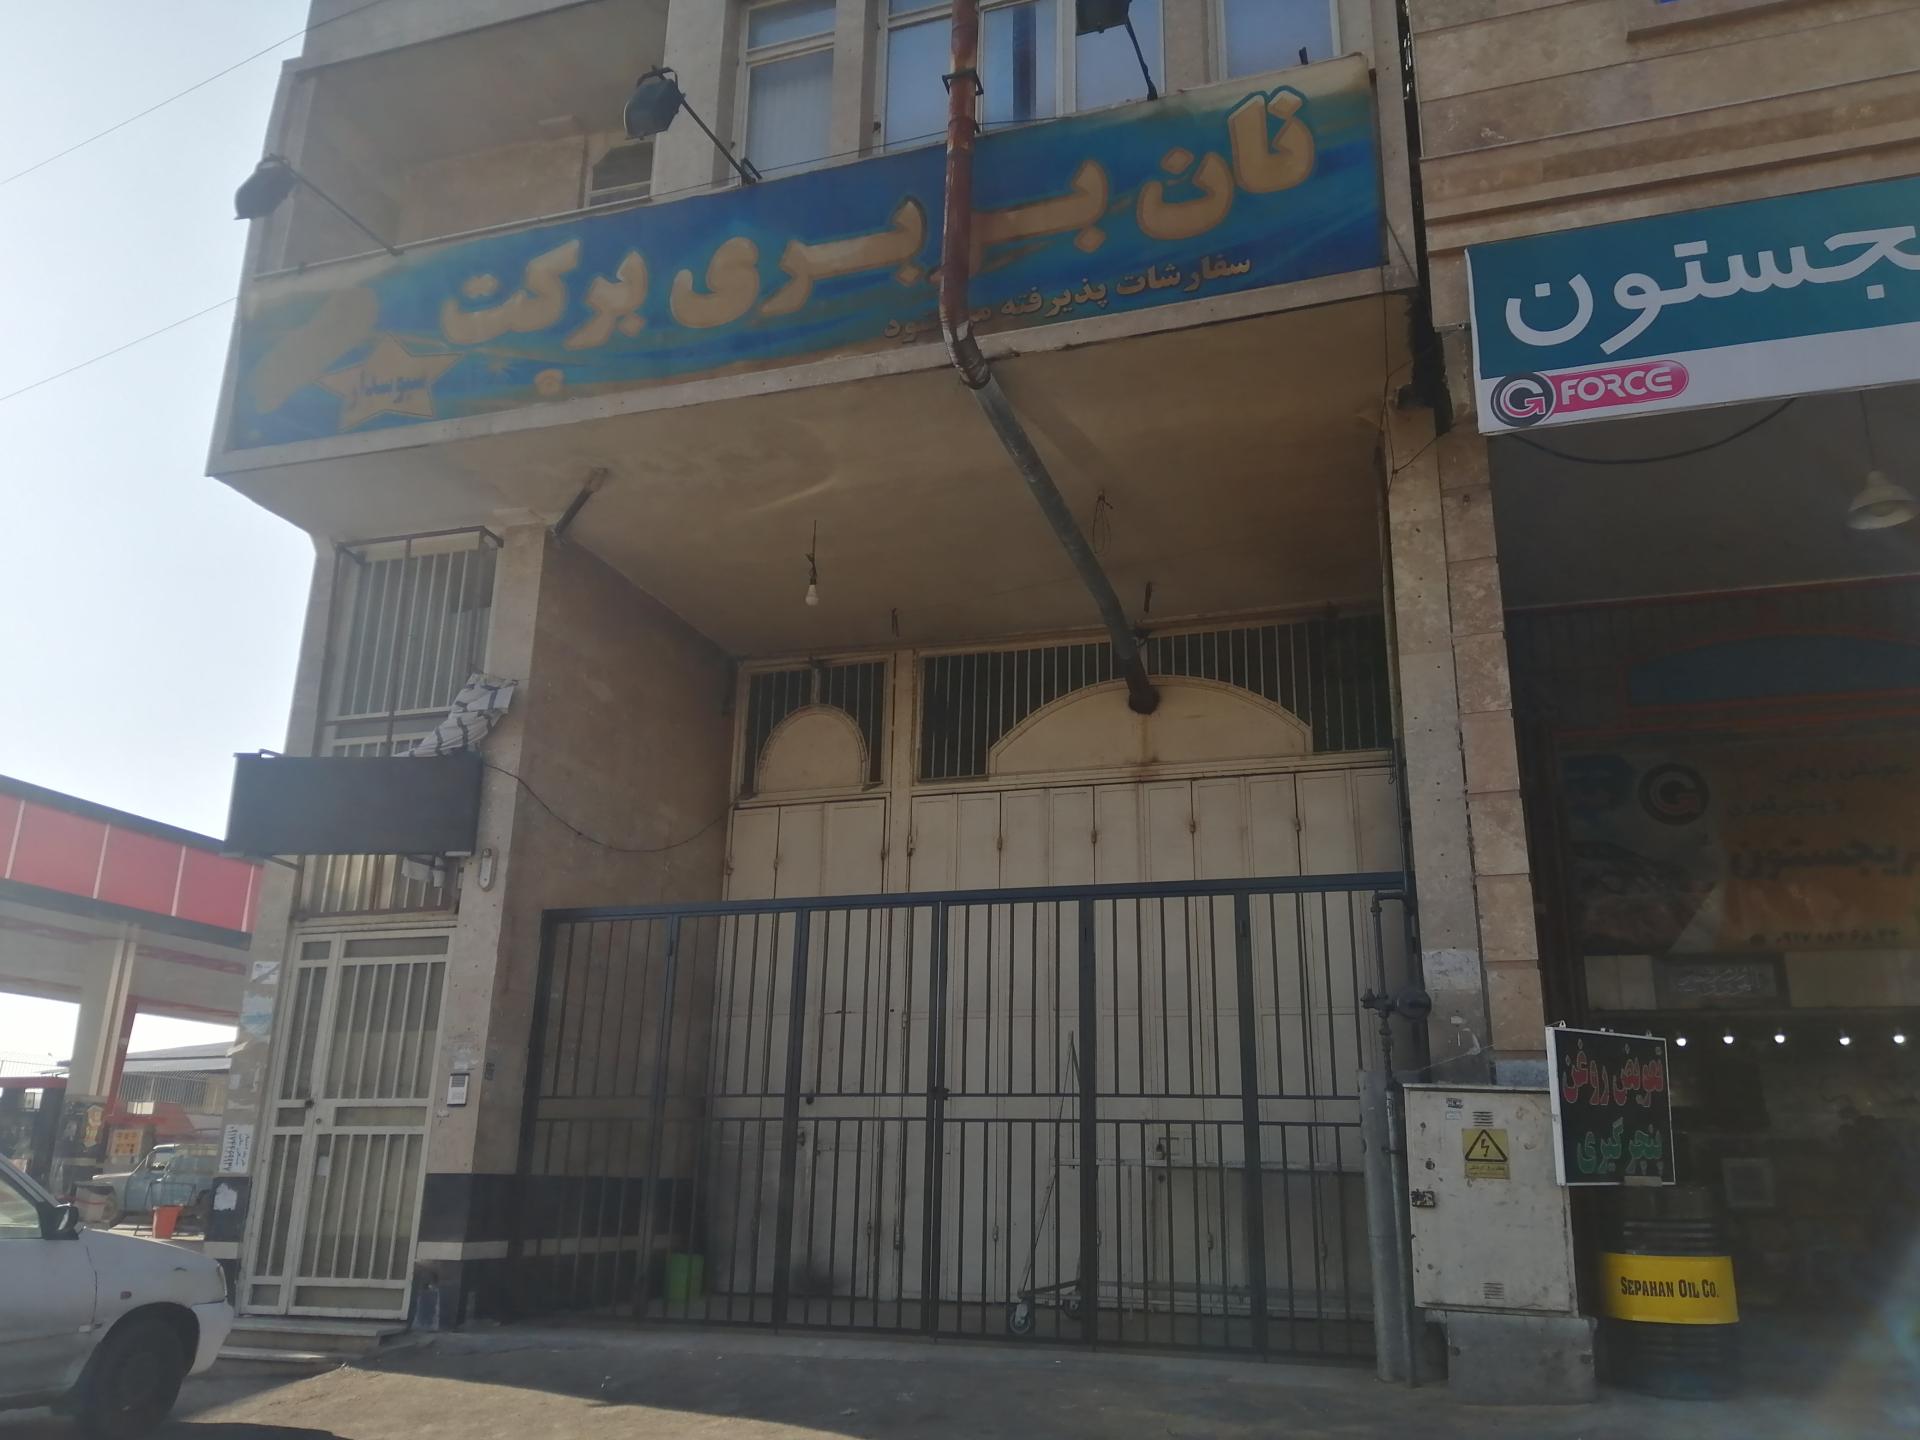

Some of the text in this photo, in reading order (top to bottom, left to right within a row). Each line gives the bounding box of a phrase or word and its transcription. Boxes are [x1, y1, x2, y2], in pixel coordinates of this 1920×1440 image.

[440, 87, 1316, 351] نان بربری برکت
[1116, 254, 1252, 296] سفارشات
[1505, 225, 1920, 355] جستون
[1001, 276, 1109, 319] پذیرفته
[1560, 365, 1674, 406] FORCE
[1562, 1038, 1609, 1105] روغن
[1620, 1275, 1675, 1298] SEPAHAN
